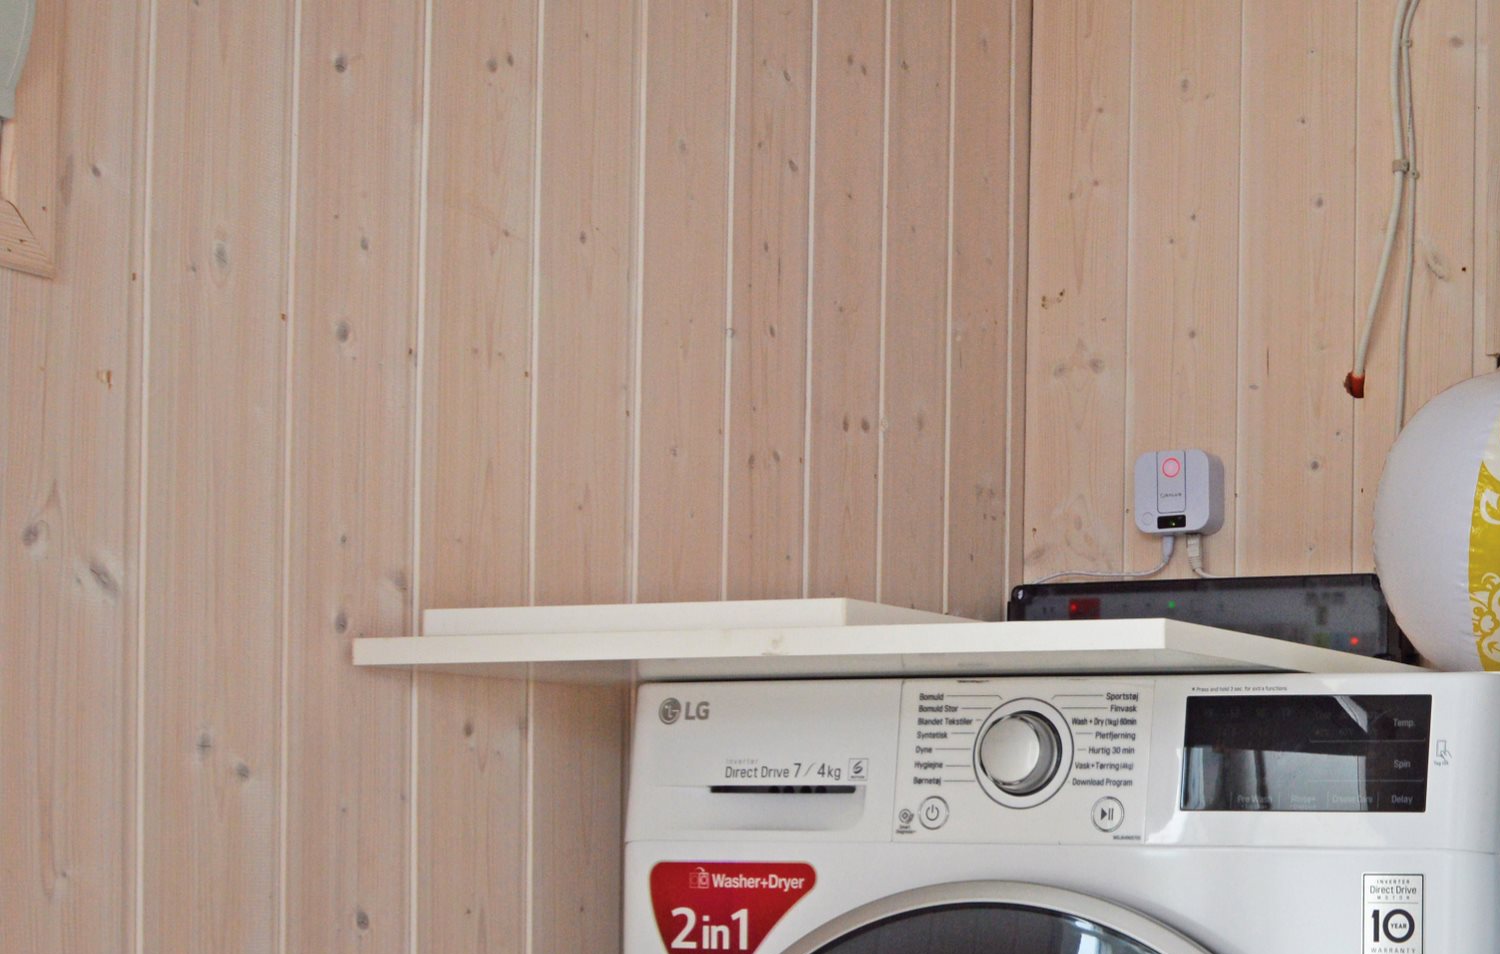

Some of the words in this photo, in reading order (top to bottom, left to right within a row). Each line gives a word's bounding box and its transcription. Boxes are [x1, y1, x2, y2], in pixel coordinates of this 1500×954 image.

[1106, 692, 1139, 701] Sportstøj
[685, 701, 710, 720] LG
[1110, 704, 1137, 712] Finvask
[917, 718, 943, 726] Blandet
[1393, 717, 1416, 729] Temp.
[916, 731, 948, 740] Syntetisk
[1095, 731, 1136, 742] Pletfjerning
[915, 746, 933, 754] Dyne
[1088, 746, 1111, 755] Hurtig
[1112, 746, 1120, 754] 30
[1122, 746, 1135, 754] min
[1075, 761, 1090, 769] Vask
[1095, 761, 1120, 771] Tørring
[1393, 759, 1411, 770] Spin
[725, 766, 758, 778] Direct
[761, 766, 789, 778] Drive
[793, 763, 802, 778] 7
[1072, 777, 1105, 786] Download
[1105, 777, 1133, 788] Program
[1391, 794, 1414, 806] Delay
[712, 873, 805, 892] Washer+Dryer
[1369, 886, 1394, 894] Direct
[1396, 886, 1417, 895] Drive
[1371, 908, 1416, 943] 10
